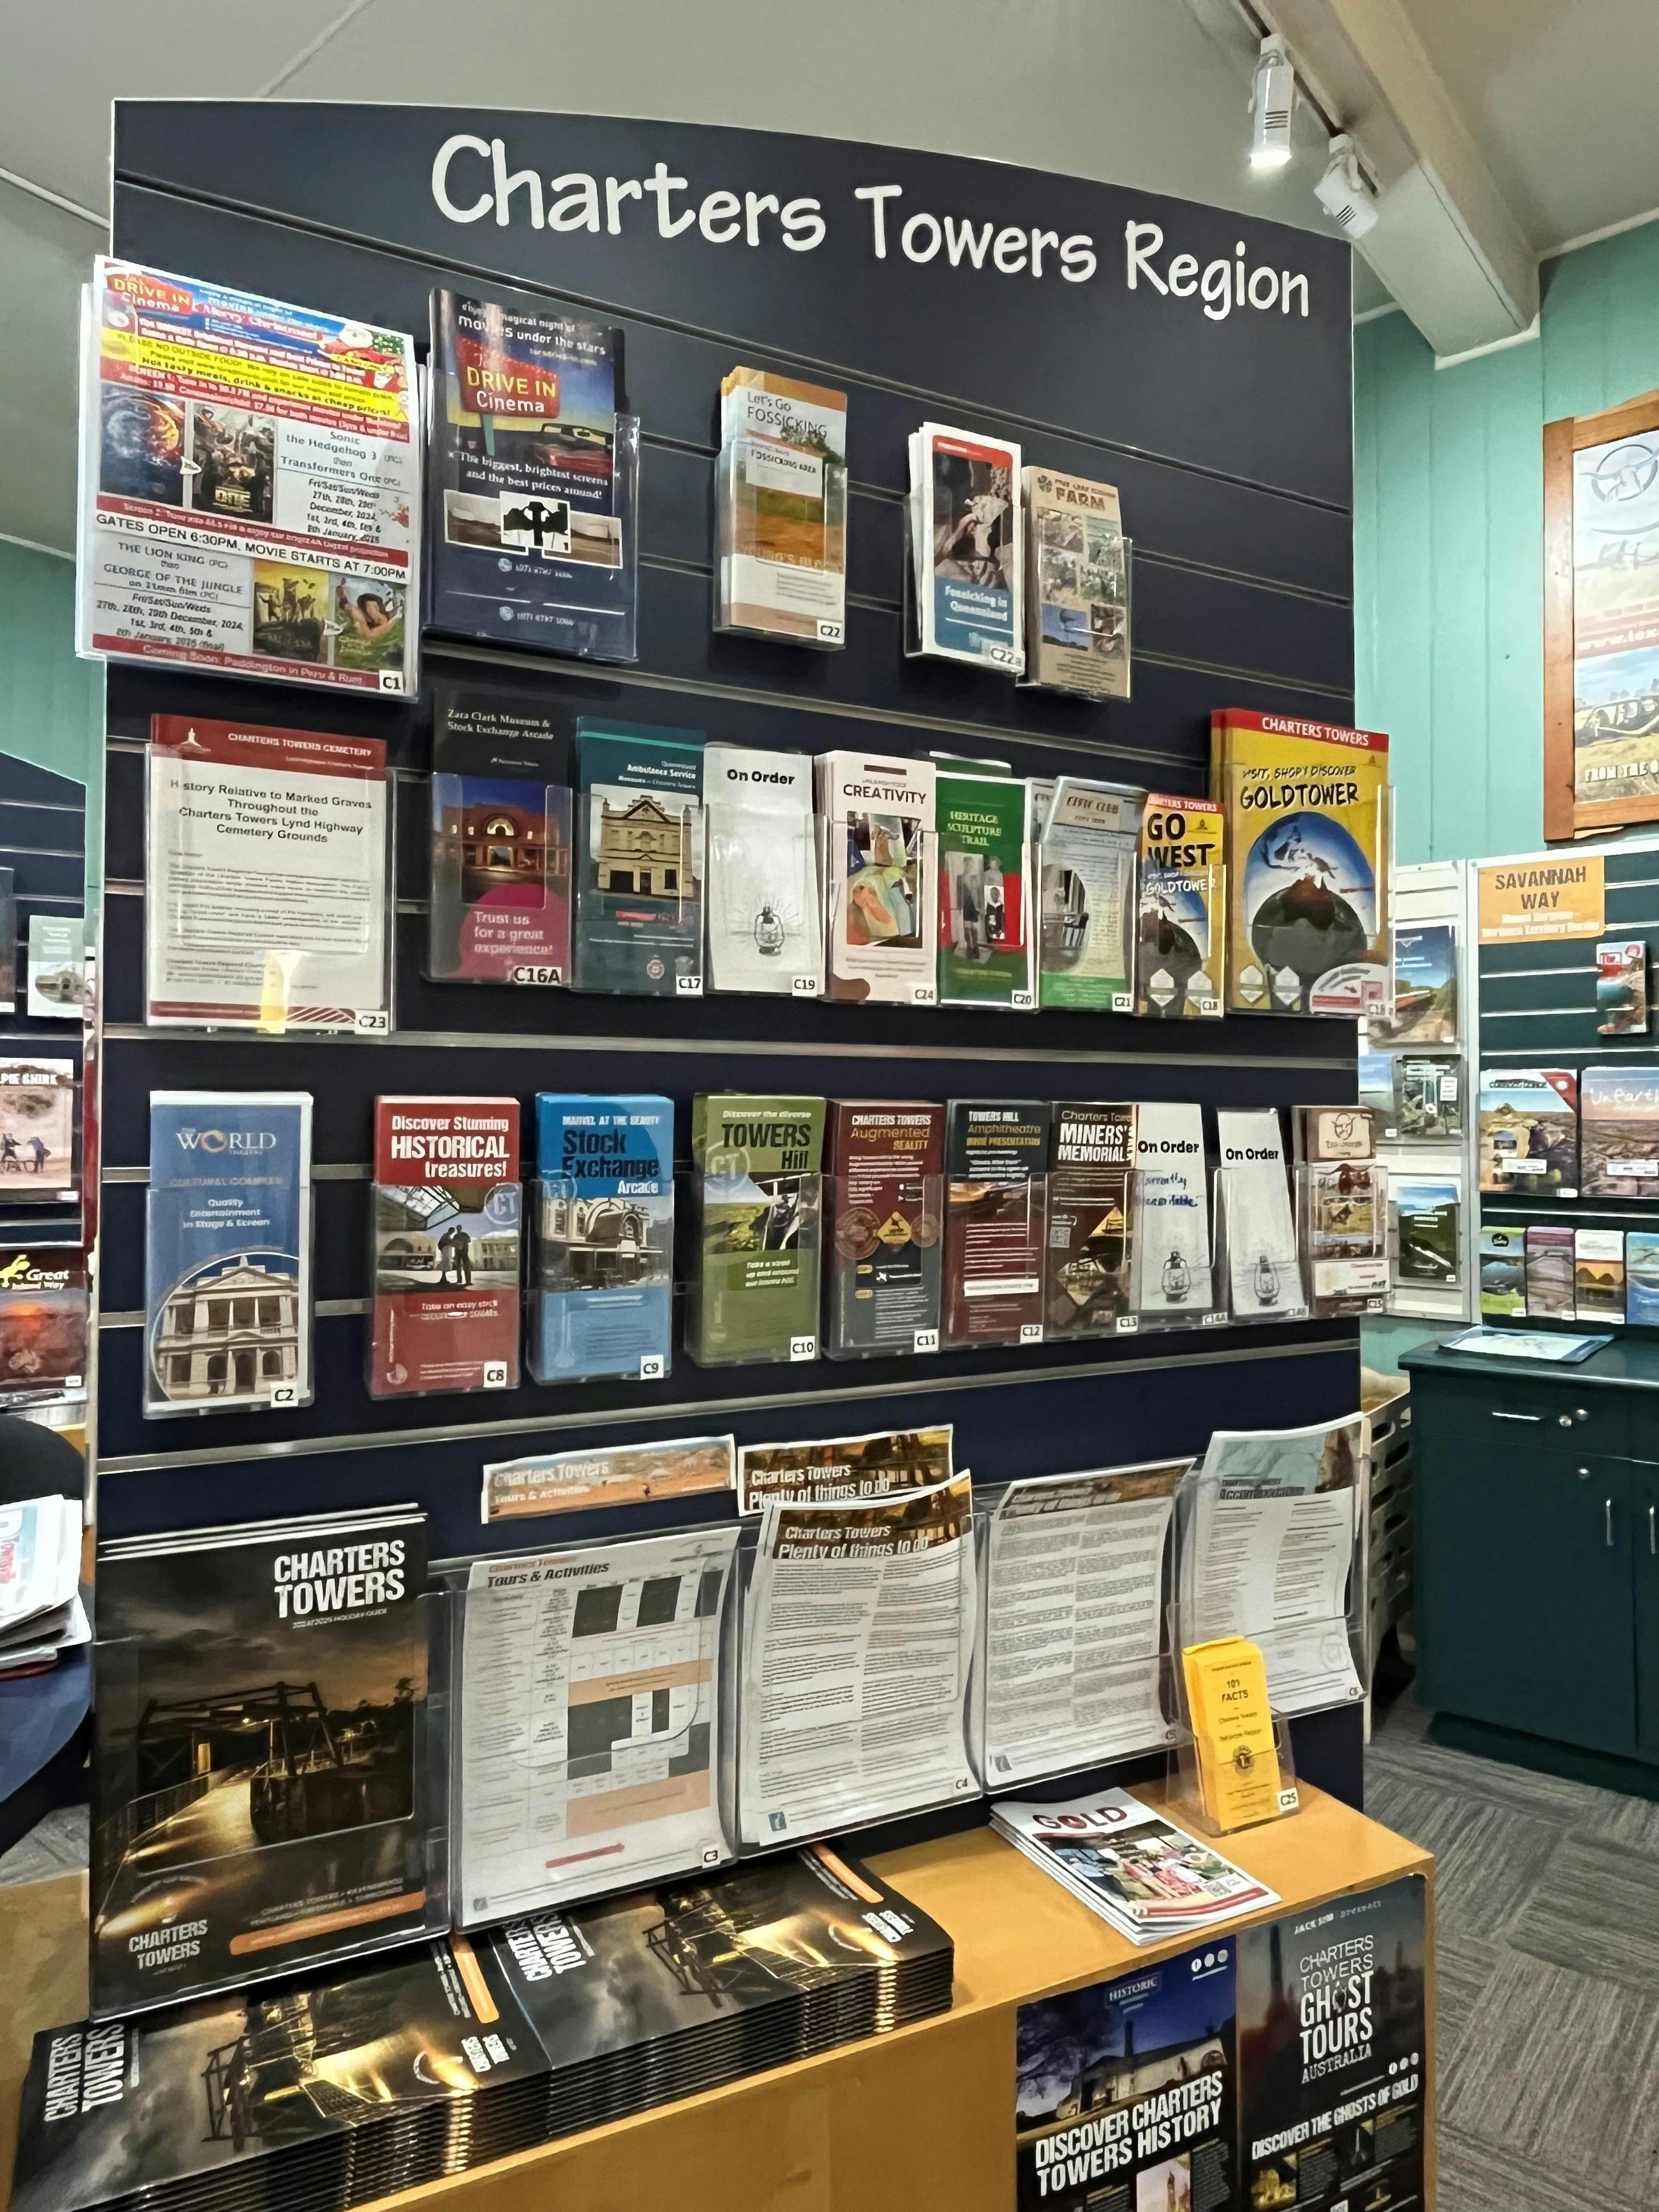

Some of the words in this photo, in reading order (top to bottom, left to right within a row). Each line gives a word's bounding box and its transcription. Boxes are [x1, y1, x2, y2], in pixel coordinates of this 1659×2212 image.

[431, 134, 825, 250] Charters
[855, 184, 1097, 281] Towers
[1126, 221, 1309, 321] Region
[114, 278, 166, 300] DRIVE
[172, 293, 190, 306] IN
[555, 336, 573, 348] the
[577, 342, 606, 355] stars
[467, 366, 529, 395] DRIVE
[535, 381, 556, 398] IN
[476, 390, 545, 413] Cinema
[747, 392, 772, 408] Let's
[776, 398, 792, 413] Go
[747, 406, 827, 439] FOSSICKING
[287, 435, 304, 444] the
[330, 432, 360, 444] Sonic
[280, 456, 356, 478] Transformers
[466, 470, 486, 479] and
[488, 473, 505, 484] the
[507, 477, 528, 487] best
[532, 481, 561, 492] prices
[1056, 487, 1105, 511] FARM
[97, 514, 145, 532] GATES
[148, 523, 187, 541] OPEN
[245, 541, 287, 558] MOVIE
[291, 551, 341, 568] STARTS
[344, 560, 359, 572] AT
[363, 563, 405, 580] 7:00PM
[119, 542, 141, 554] THE
[820, 625, 840, 637] C22
[382, 676, 401, 689] C1
[447, 721, 474, 732] Stock
[1262, 716, 1322, 739] CHARTERS
[1325, 726, 1369, 746] TOWERS
[727, 769, 748, 782] On
[751, 771, 795, 786] Order
[1585, 767, 1617, 782] FROM
[1622, 761, 1649, 777] THE
[170, 779, 215, 795] Hstory
[218, 784, 267, 799] Relative
[270, 791, 281, 800] to
[286, 792, 328, 805] Marked
[331, 797, 373, 809] Graves
[843, 783, 927, 804] CREATIVITY
[1239, 782, 1360, 810] GOLDTOWER
[228, 799, 297, 816] Throughout
[301, 807, 319, 816] the
[179, 807, 232, 821] Charters
[235, 812, 278, 826] Towers
[282, 817, 311, 830] Lynd
[314, 820, 363, 835] Highway
[1147, 812, 1186, 840] GO
[217, 823, 274, 839] Cemetery
[278, 830, 328, 844] Grounds
[962, 835, 990, 847] TRAIL
[1148, 843, 1215, 867] WEST
[1495, 866, 1586, 890] SAVANNAH
[1521, 891, 1559, 910] WAY
[474, 911, 509, 925] Trust
[513, 914, 530, 925] us
[474, 926, 494, 938] for
[510, 929, 544, 945] great
[514, 967, 561, 984] C16A
[678, 978, 701, 989] C17
[794, 978, 815, 989] C19
[1013, 994, 1032, 1005] C20
[1114, 996, 1131, 1007] C21
[359, 1015, 386, 1029] C23
[392, 1115, 451, 1131] Discover
[1062, 1110, 1108, 1121] Charters
[176, 1130, 276, 1153] WORLD
[562, 1128, 627, 1155] Stock
[721, 1123, 812, 1148] TOWERS
[850, 1127, 930, 1142] Augmented
[1059, 1123, 1127, 1146] MINERS'
[391, 1136, 510, 1159] HISTORICAL
[1058, 1145, 1125, 1162] MEMORIAL
[1138, 1141, 1158, 1153] On
[1160, 1141, 1199, 1153] Order
[1226, 1148, 1243, 1160] On
[1246, 1148, 1279, 1160] Order
[425, 1161, 507, 1178] treasures!
[561, 1155, 659, 1180] Exchange
[781, 1150, 809, 1170] Hill
[617, 1180, 659, 1195] Arcade
[26, 1269, 69, 1281] Great
[917, 1334, 935, 1346] C11
[1023, 1327, 1040, 1336] C12
[792, 1342, 814, 1354] C10
[487, 1369, 505, 1383] C8
[643, 1362, 659, 1375] C9
[274, 1389, 294, 1402] C2
[558, 1460, 609, 1479] Towers
[751, 1468, 805, 1486] Charters
[806, 1464, 851, 1480] Towers
[494, 1492, 526, 1504] Tours
[528, 1491, 538, 1500] &
[798, 1488, 812, 1502] of
[815, 1483, 856, 1502] things
[859, 1481, 872, 1496] to
[874, 1478, 890, 1493] do
[785, 1526, 842, 1541] Charters
[844, 1525, 891, 1539] Towers
[778, 1544, 826, 1560] Plenty
[831, 1543, 847, 1558] of
[849, 1542, 894, 1558] things
[896, 1539, 911, 1554] to
[913, 1537, 929, 1553] do
[274, 1539, 405, 1583] CHARTERS
[488, 1574, 528, 1588] Tours
[531, 1571, 541, 1582] &
[544, 1564, 610, 1580] Activities
[274, 1568, 405, 1618] TOWERS
[1222, 1690, 1249, 1702] FACTS
[956, 1778, 968, 1790] C4
[1032, 1806, 1127, 1830] GOLD
[703, 1850, 719, 1862] C3
[128, 1920, 208, 1953] CHARTERS
[137, 1940, 201, 1971] TOWERS
[1300, 1934, 1374, 1973] CHARTERS
[1300, 1954, 1374, 1991] TOWERS
[1109, 1977, 1158, 2001] HISTORIC
[1300, 1970, 1374, 2028] GHOST
[1299, 2007, 1373, 2064] TOURS
[81, 2023, 125, 2113] TOWERS
[1301, 2043, 1372, 2084] AUSTRALIA
[43, 2032, 83, 2124] CHARTERS
[1035, 2109, 1130, 2170] DISCOVER
[1132, 2070, 1223, 2130] CHARTERS
[1251, 2121, 1310, 2161] DISCOVER
[1311, 2109, 1332, 2136] THE
[1333, 2092, 1376, 2126] GHOSTS
[1378, 2087, 1390, 2106] OF
[1036, 2137, 1133, 2197] TOWERS
[1137, 2097, 1222, 2159] HISTORY
